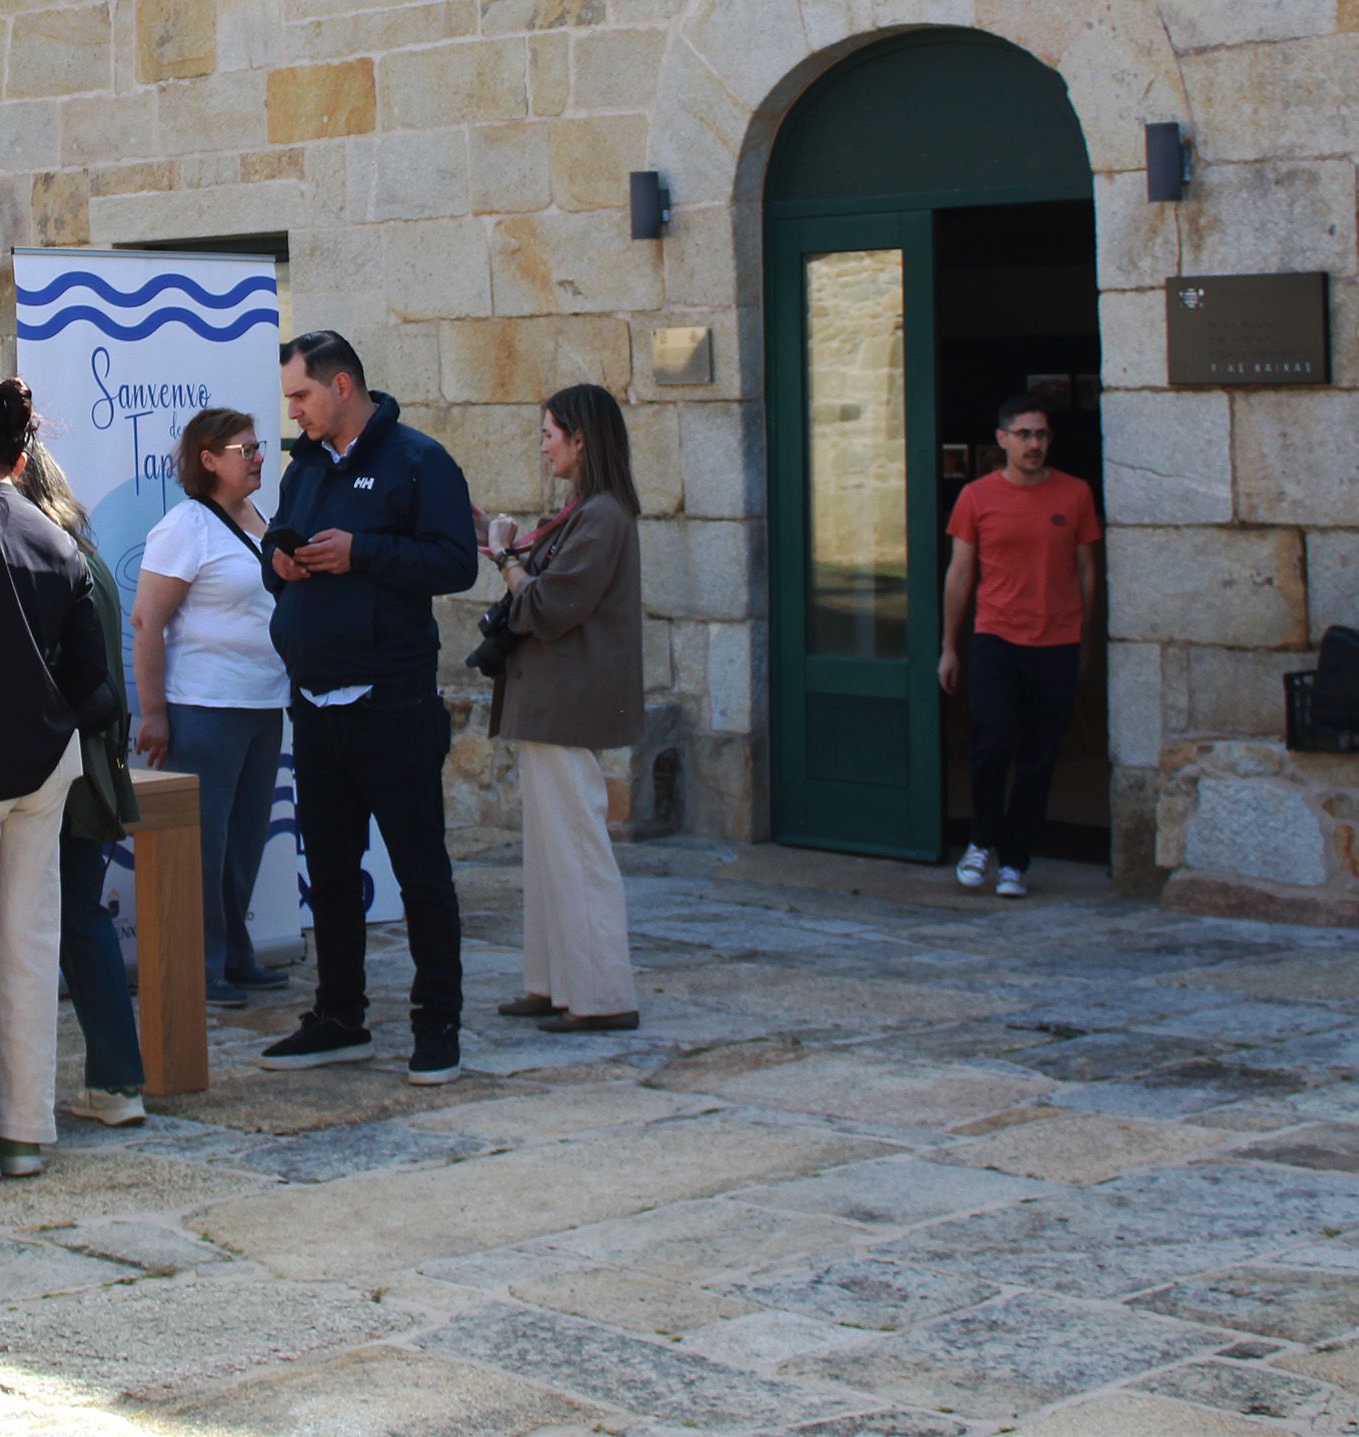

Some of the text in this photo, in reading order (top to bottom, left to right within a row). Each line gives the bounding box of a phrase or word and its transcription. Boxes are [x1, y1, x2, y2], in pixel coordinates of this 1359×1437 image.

[90, 346, 211, 430] Sanxenxo
[123, 410, 175, 516] Tap
[353, 477, 375, 490] HH
